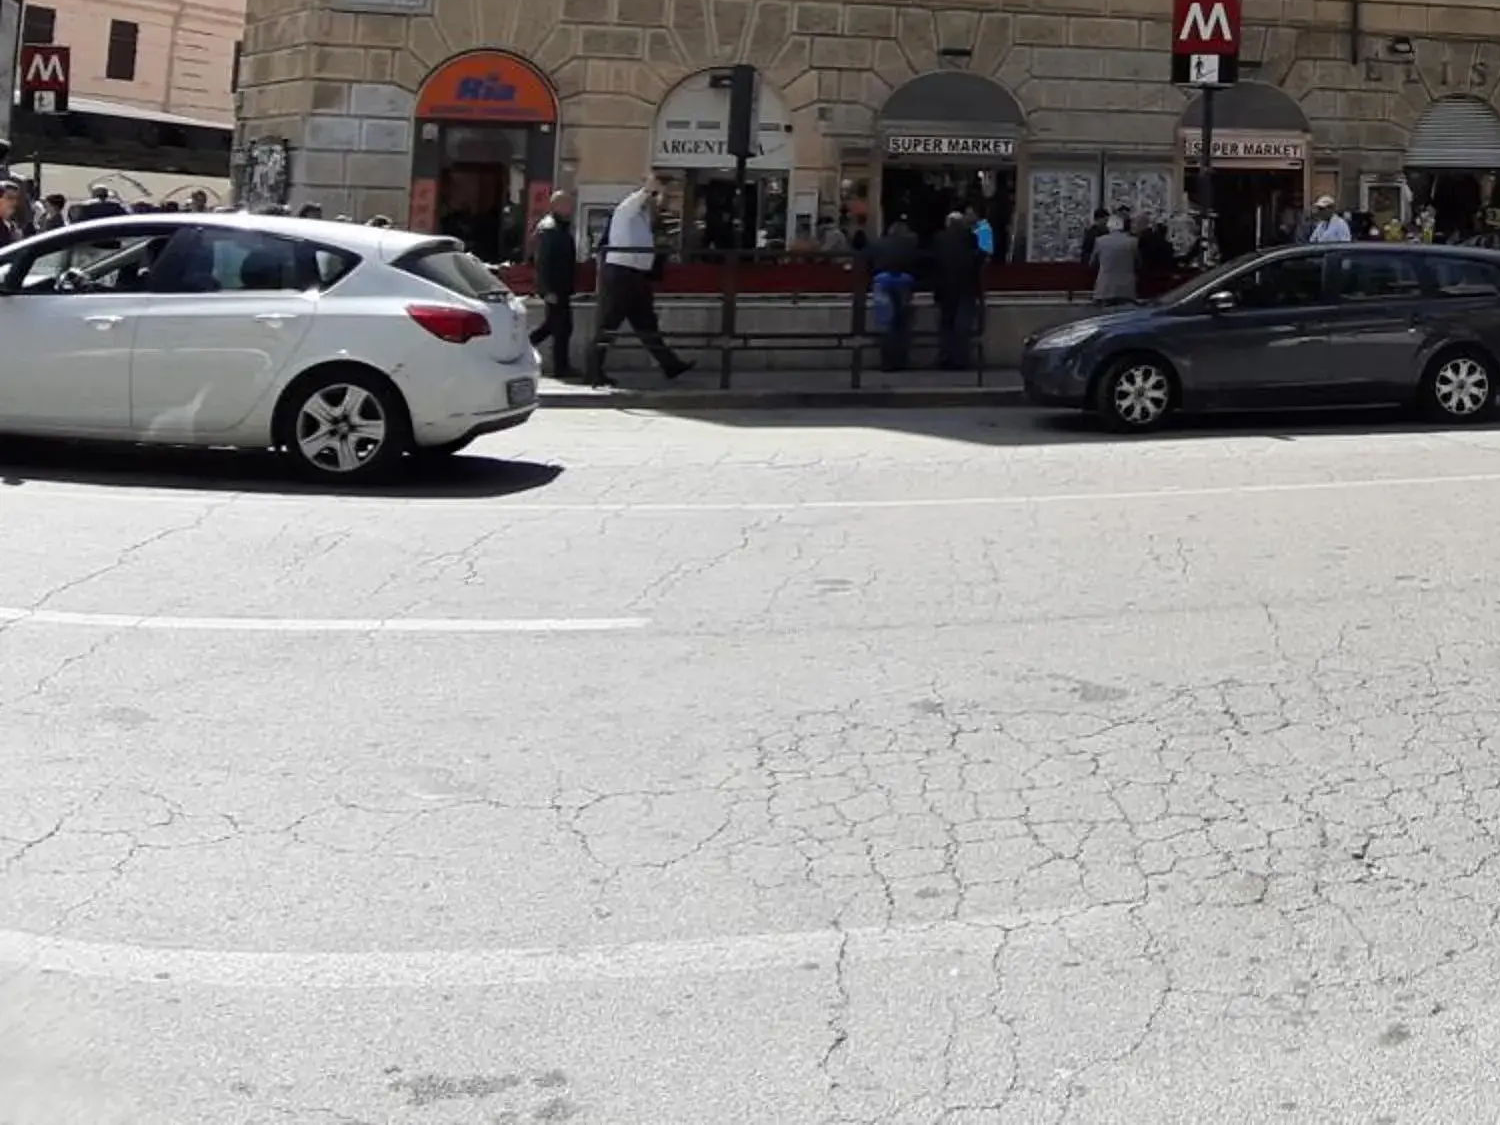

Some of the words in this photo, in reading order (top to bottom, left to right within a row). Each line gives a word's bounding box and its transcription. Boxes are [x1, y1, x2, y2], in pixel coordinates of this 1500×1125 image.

[1179, 2, 1232, 41] M
[26, 52, 65, 82] M
[891, 138, 943, 152] SUPER
[947, 139, 1013, 154] MARKET
[1193, 140, 1239, 156] SPER
[1242, 142, 1297, 158] MARKET
